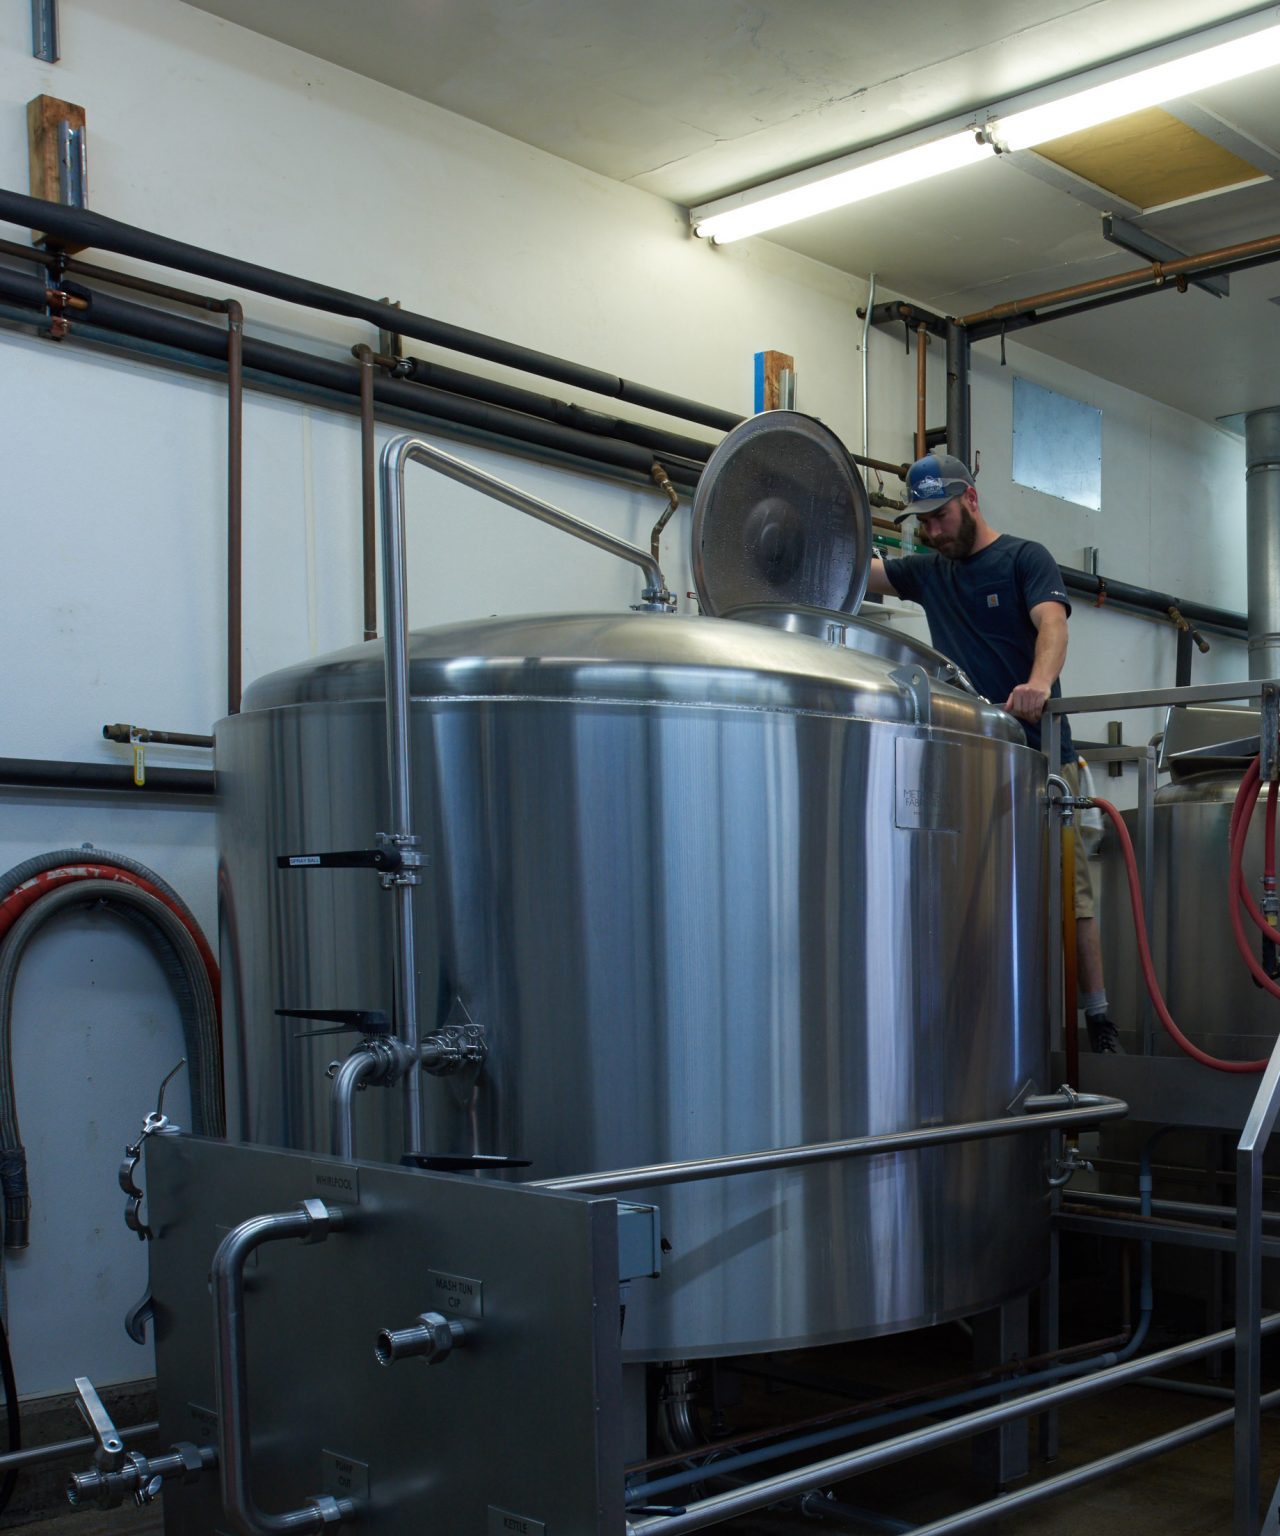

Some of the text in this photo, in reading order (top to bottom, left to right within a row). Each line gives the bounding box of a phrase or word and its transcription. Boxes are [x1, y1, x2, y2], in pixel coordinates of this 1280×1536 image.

[315, 1174, 352, 1190] WHIRLPOOL
[435, 1277, 473, 1295] MASH TUN
[447, 1296, 461, 1308] CIP
[503, 1516, 528, 1535] KETTLE
